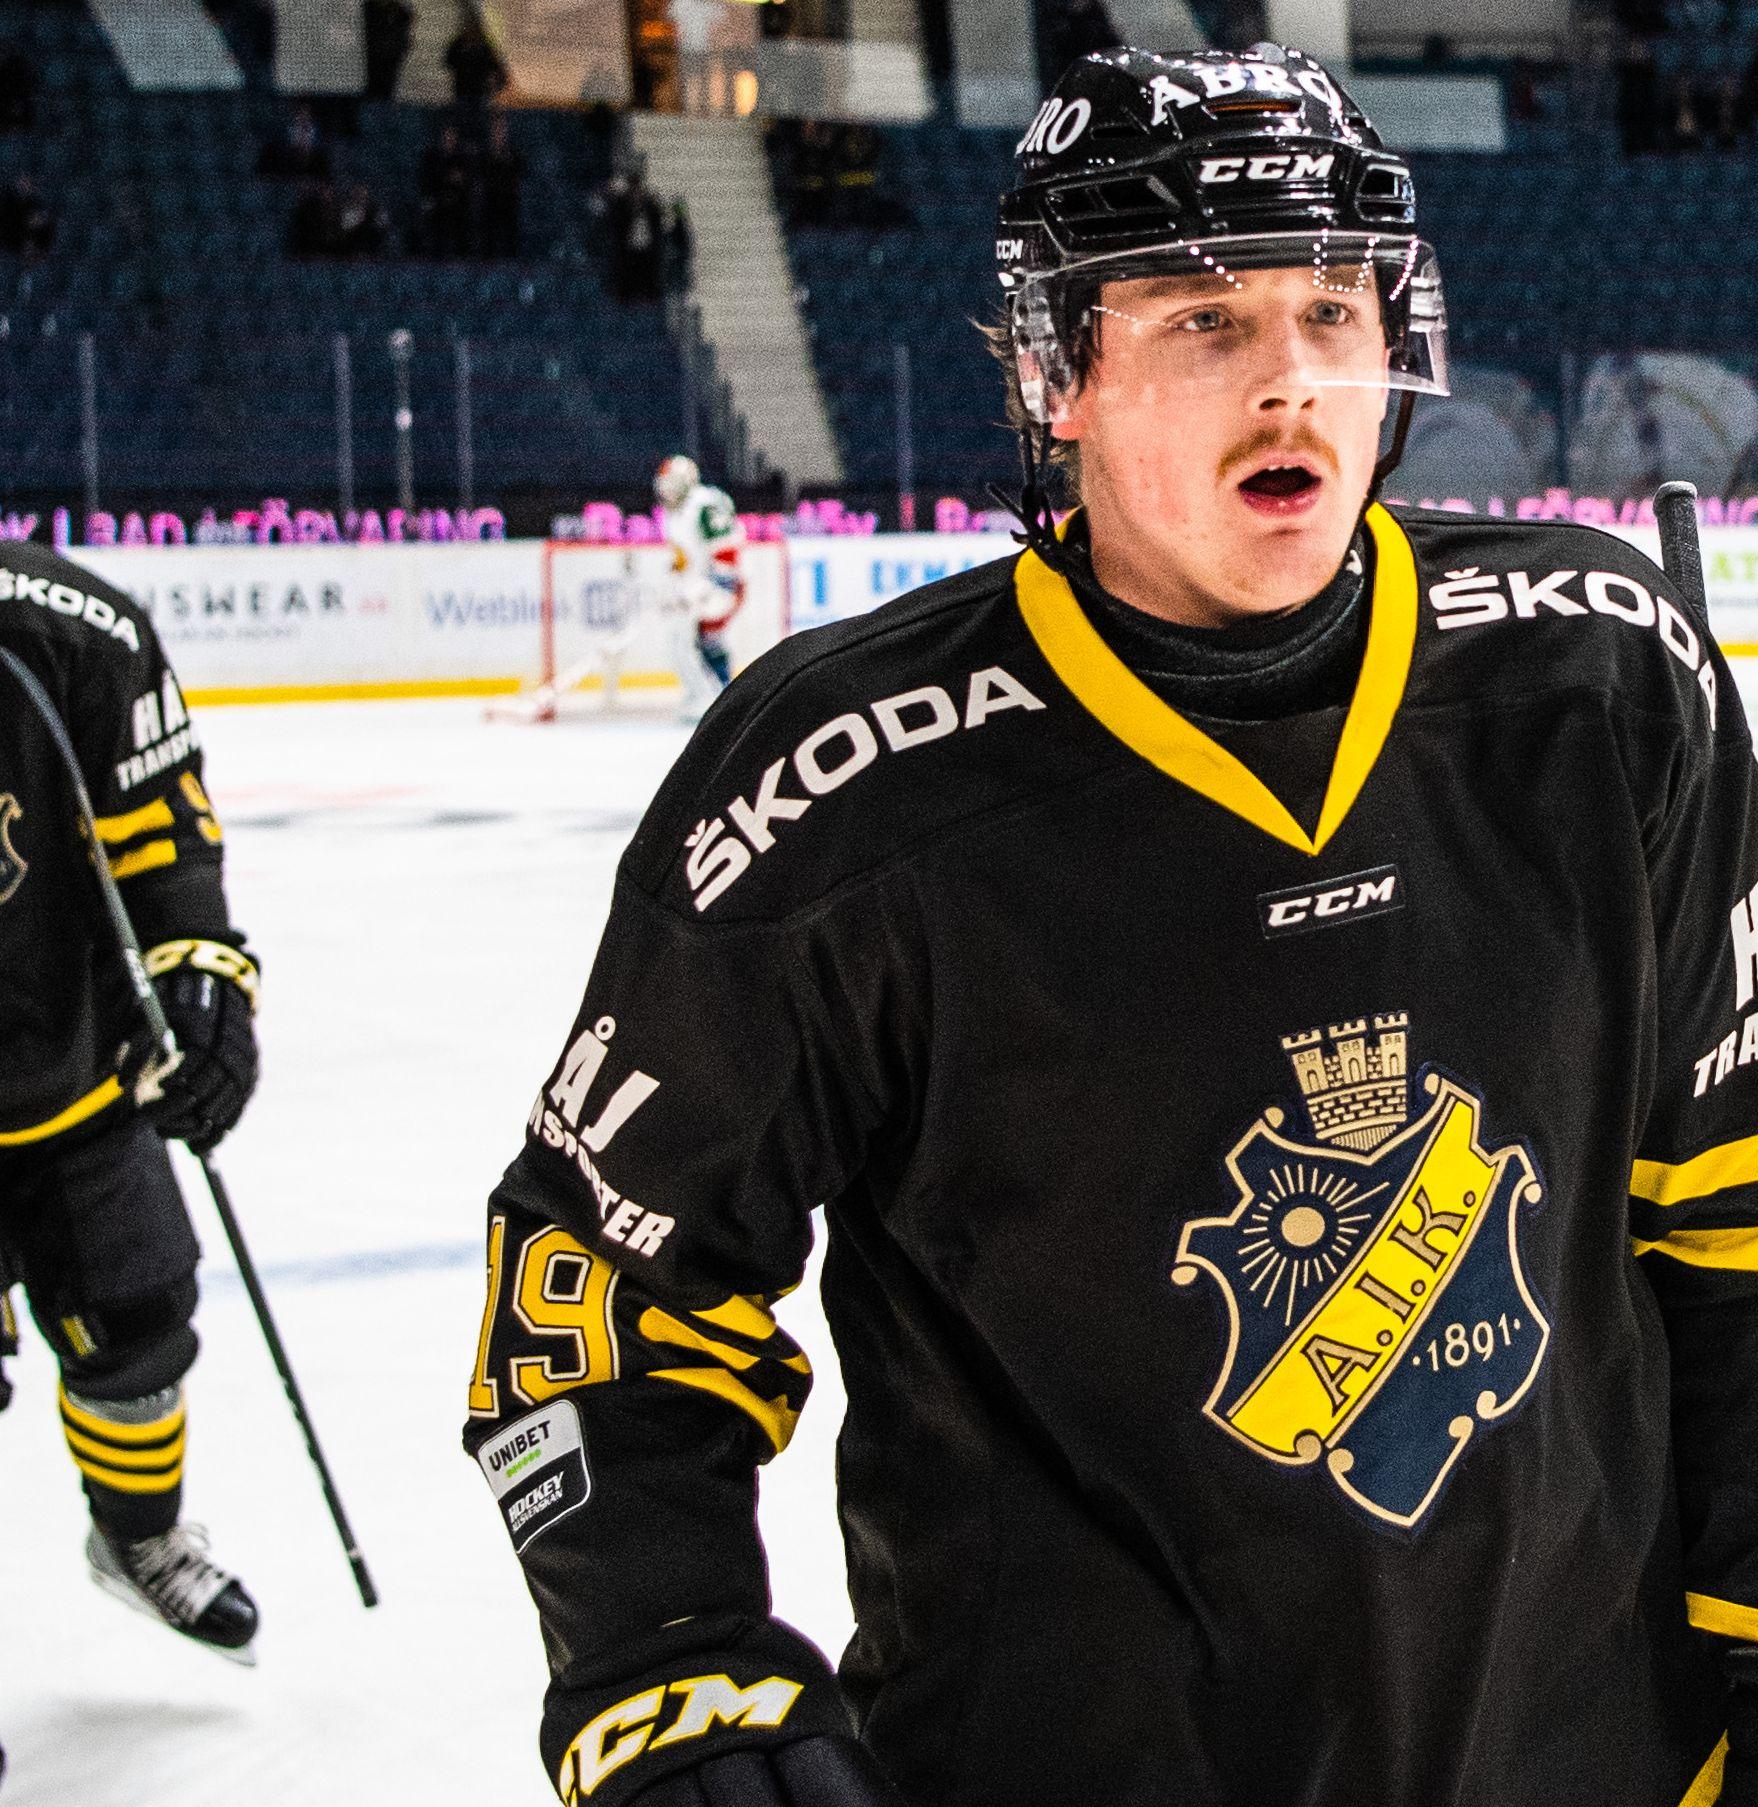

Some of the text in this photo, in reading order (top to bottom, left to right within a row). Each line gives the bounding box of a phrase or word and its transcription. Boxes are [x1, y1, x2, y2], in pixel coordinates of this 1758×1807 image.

[1200, 153, 1336, 184] CCM
[683, 664, 1047, 912] ŠKODA
[1266, 874, 1397, 929] CCM
[468, 1214, 622, 1420] 19
[1300, 1183, 1477, 1419] A.I.K.
[488, 1420, 551, 1472] UNIBET
[508, 1470, 565, 1524] HOCKEY
